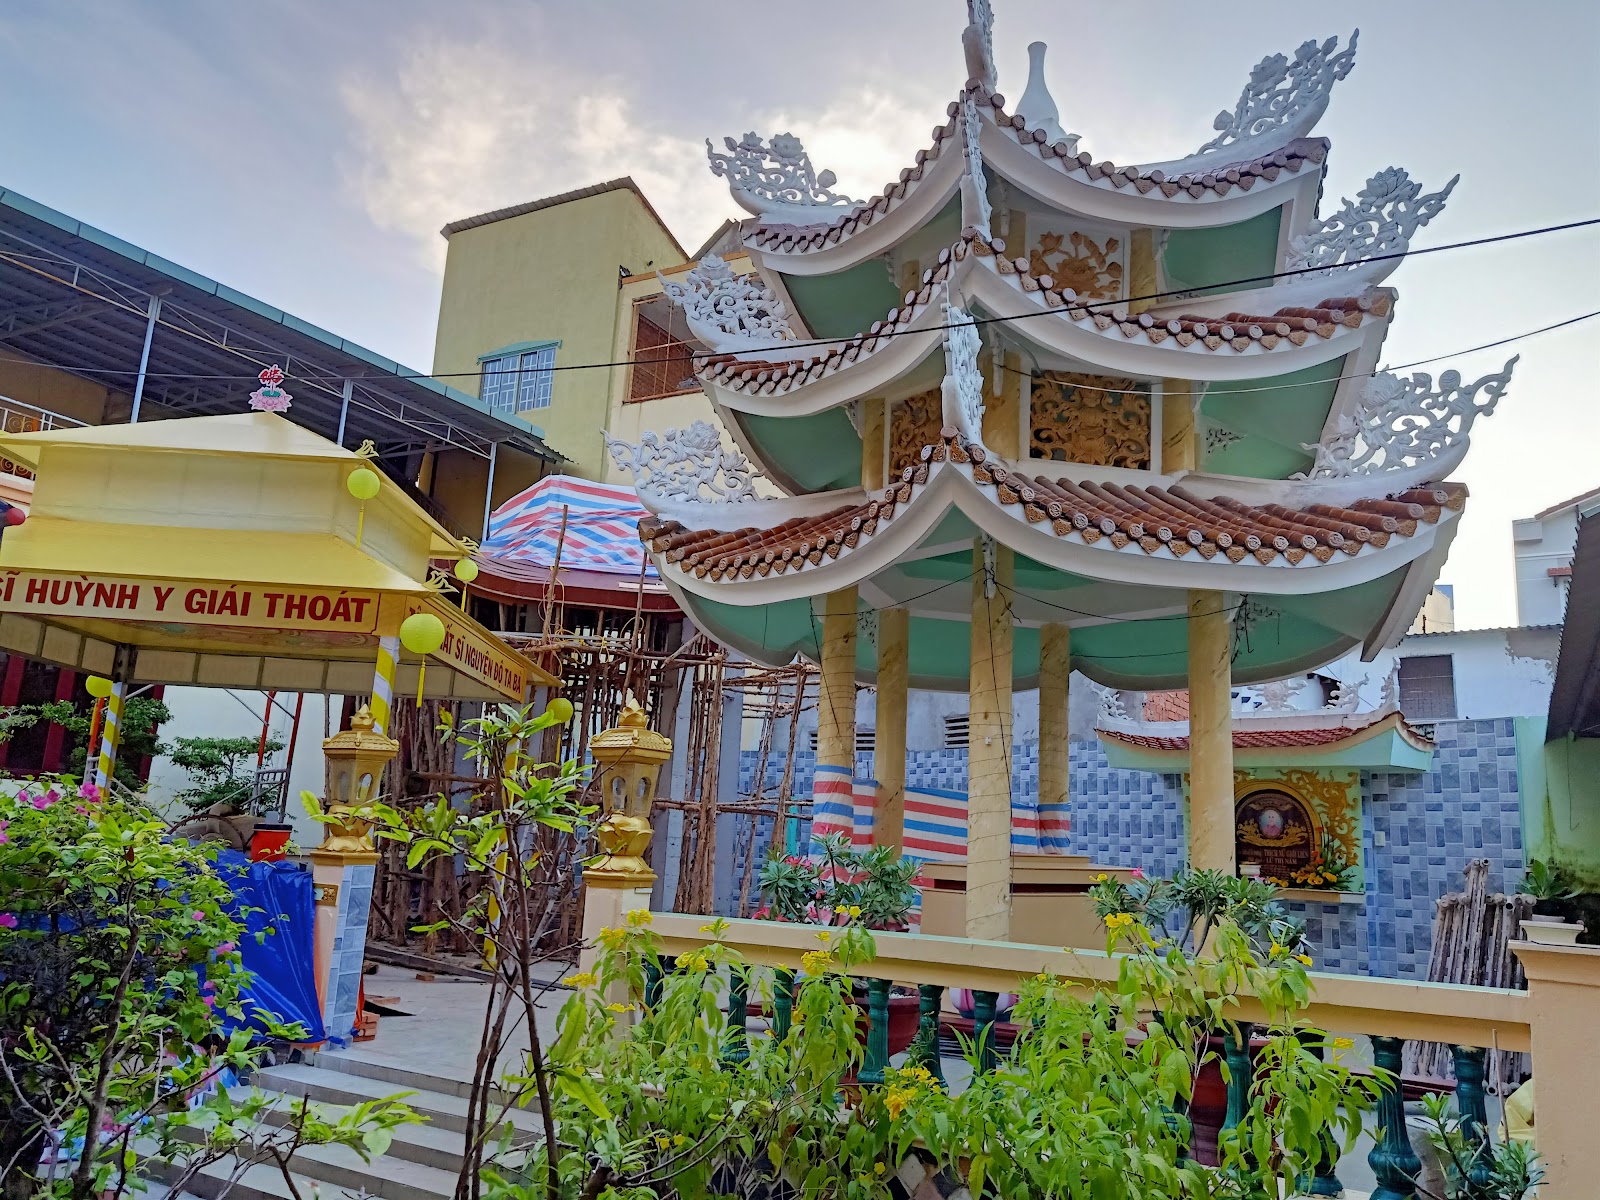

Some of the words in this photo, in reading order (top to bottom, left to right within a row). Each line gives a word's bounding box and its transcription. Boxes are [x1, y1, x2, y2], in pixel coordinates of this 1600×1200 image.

[0, 571, 20, 602] Ĩ
[25, 575, 140, 610] HUỲNH
[154, 586, 175, 612] Y
[264, 590, 371, 623] THOÁT
[455, 635, 466, 662] SĨ
[464, 643, 494, 680] NGUYỆN
[493, 659, 504, 688] ĐỘ
[504, 668, 512, 689] TA
[512, 671, 522, 694] BÀ
